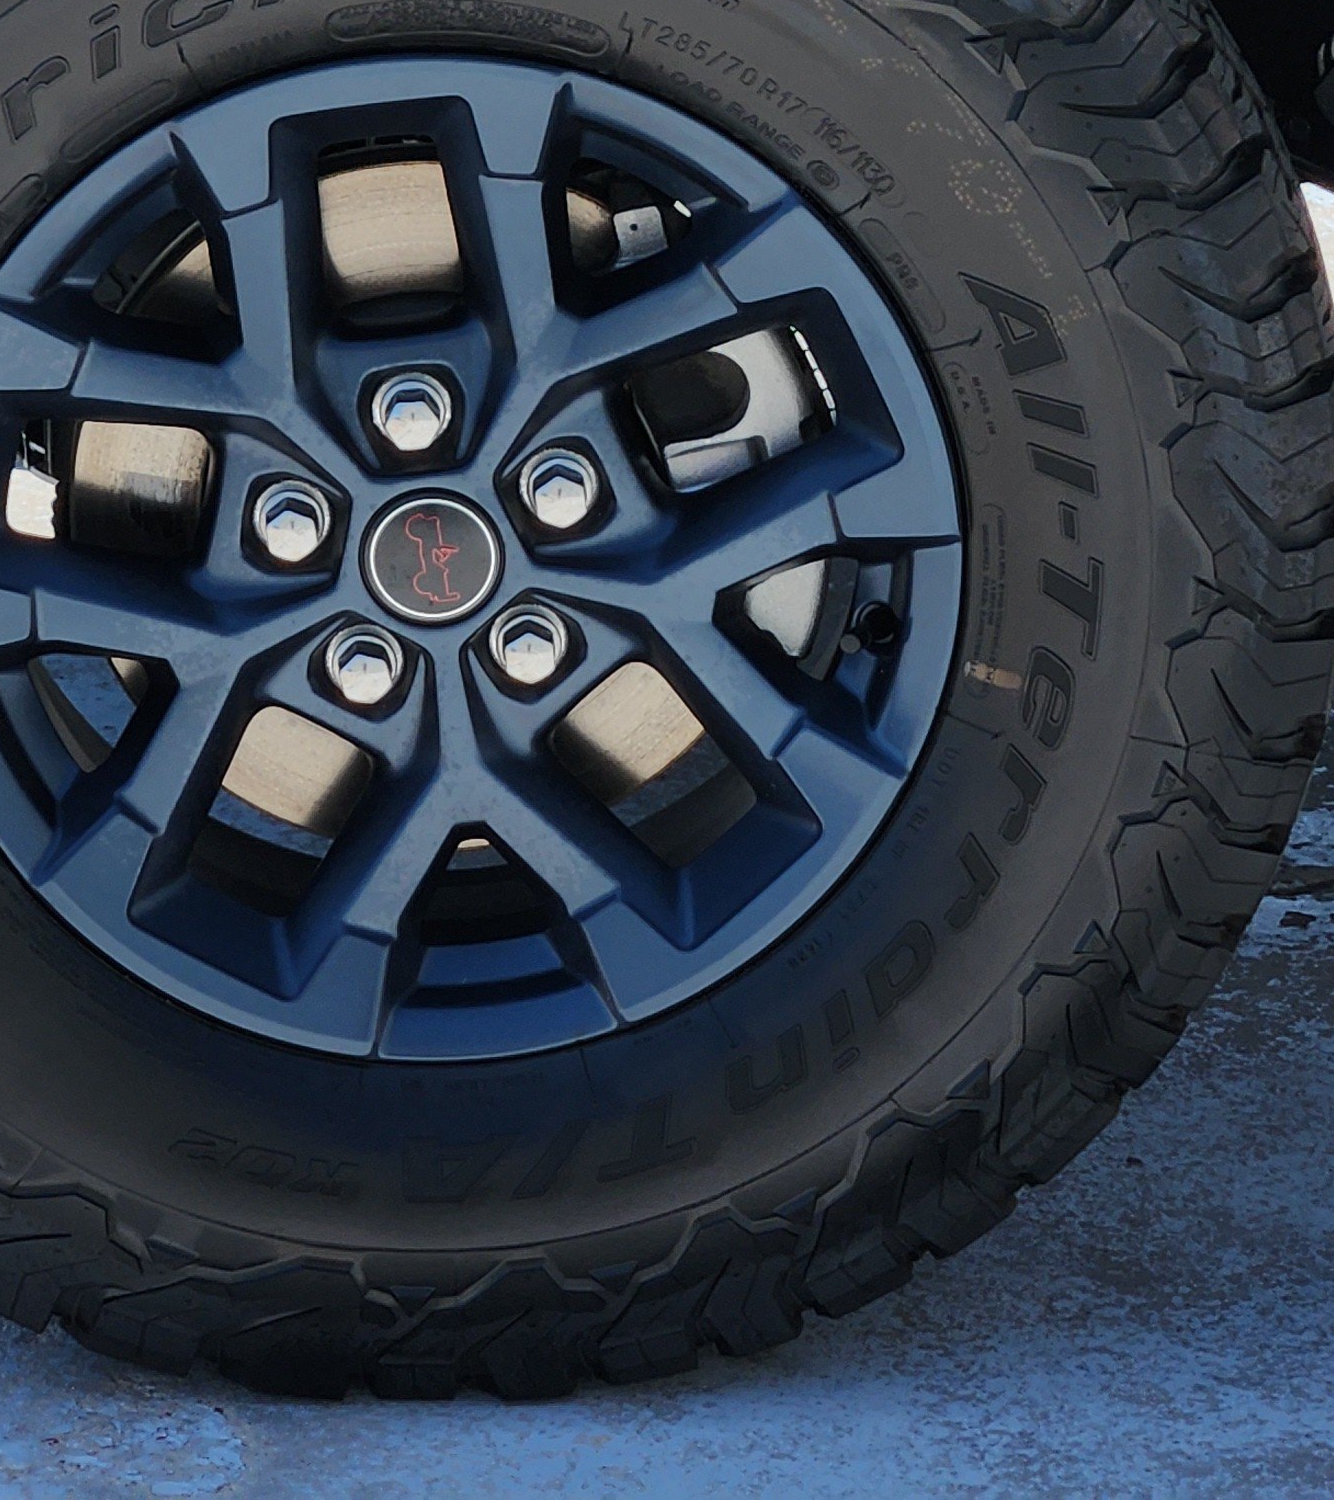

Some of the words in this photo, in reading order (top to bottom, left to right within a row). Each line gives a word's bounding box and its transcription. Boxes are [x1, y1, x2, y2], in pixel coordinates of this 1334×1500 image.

[727, 98, 807, 161] RANGE
[725, 271, 1104, 1114] All-Terrain
[401, 1092, 699, 1203] T/A
